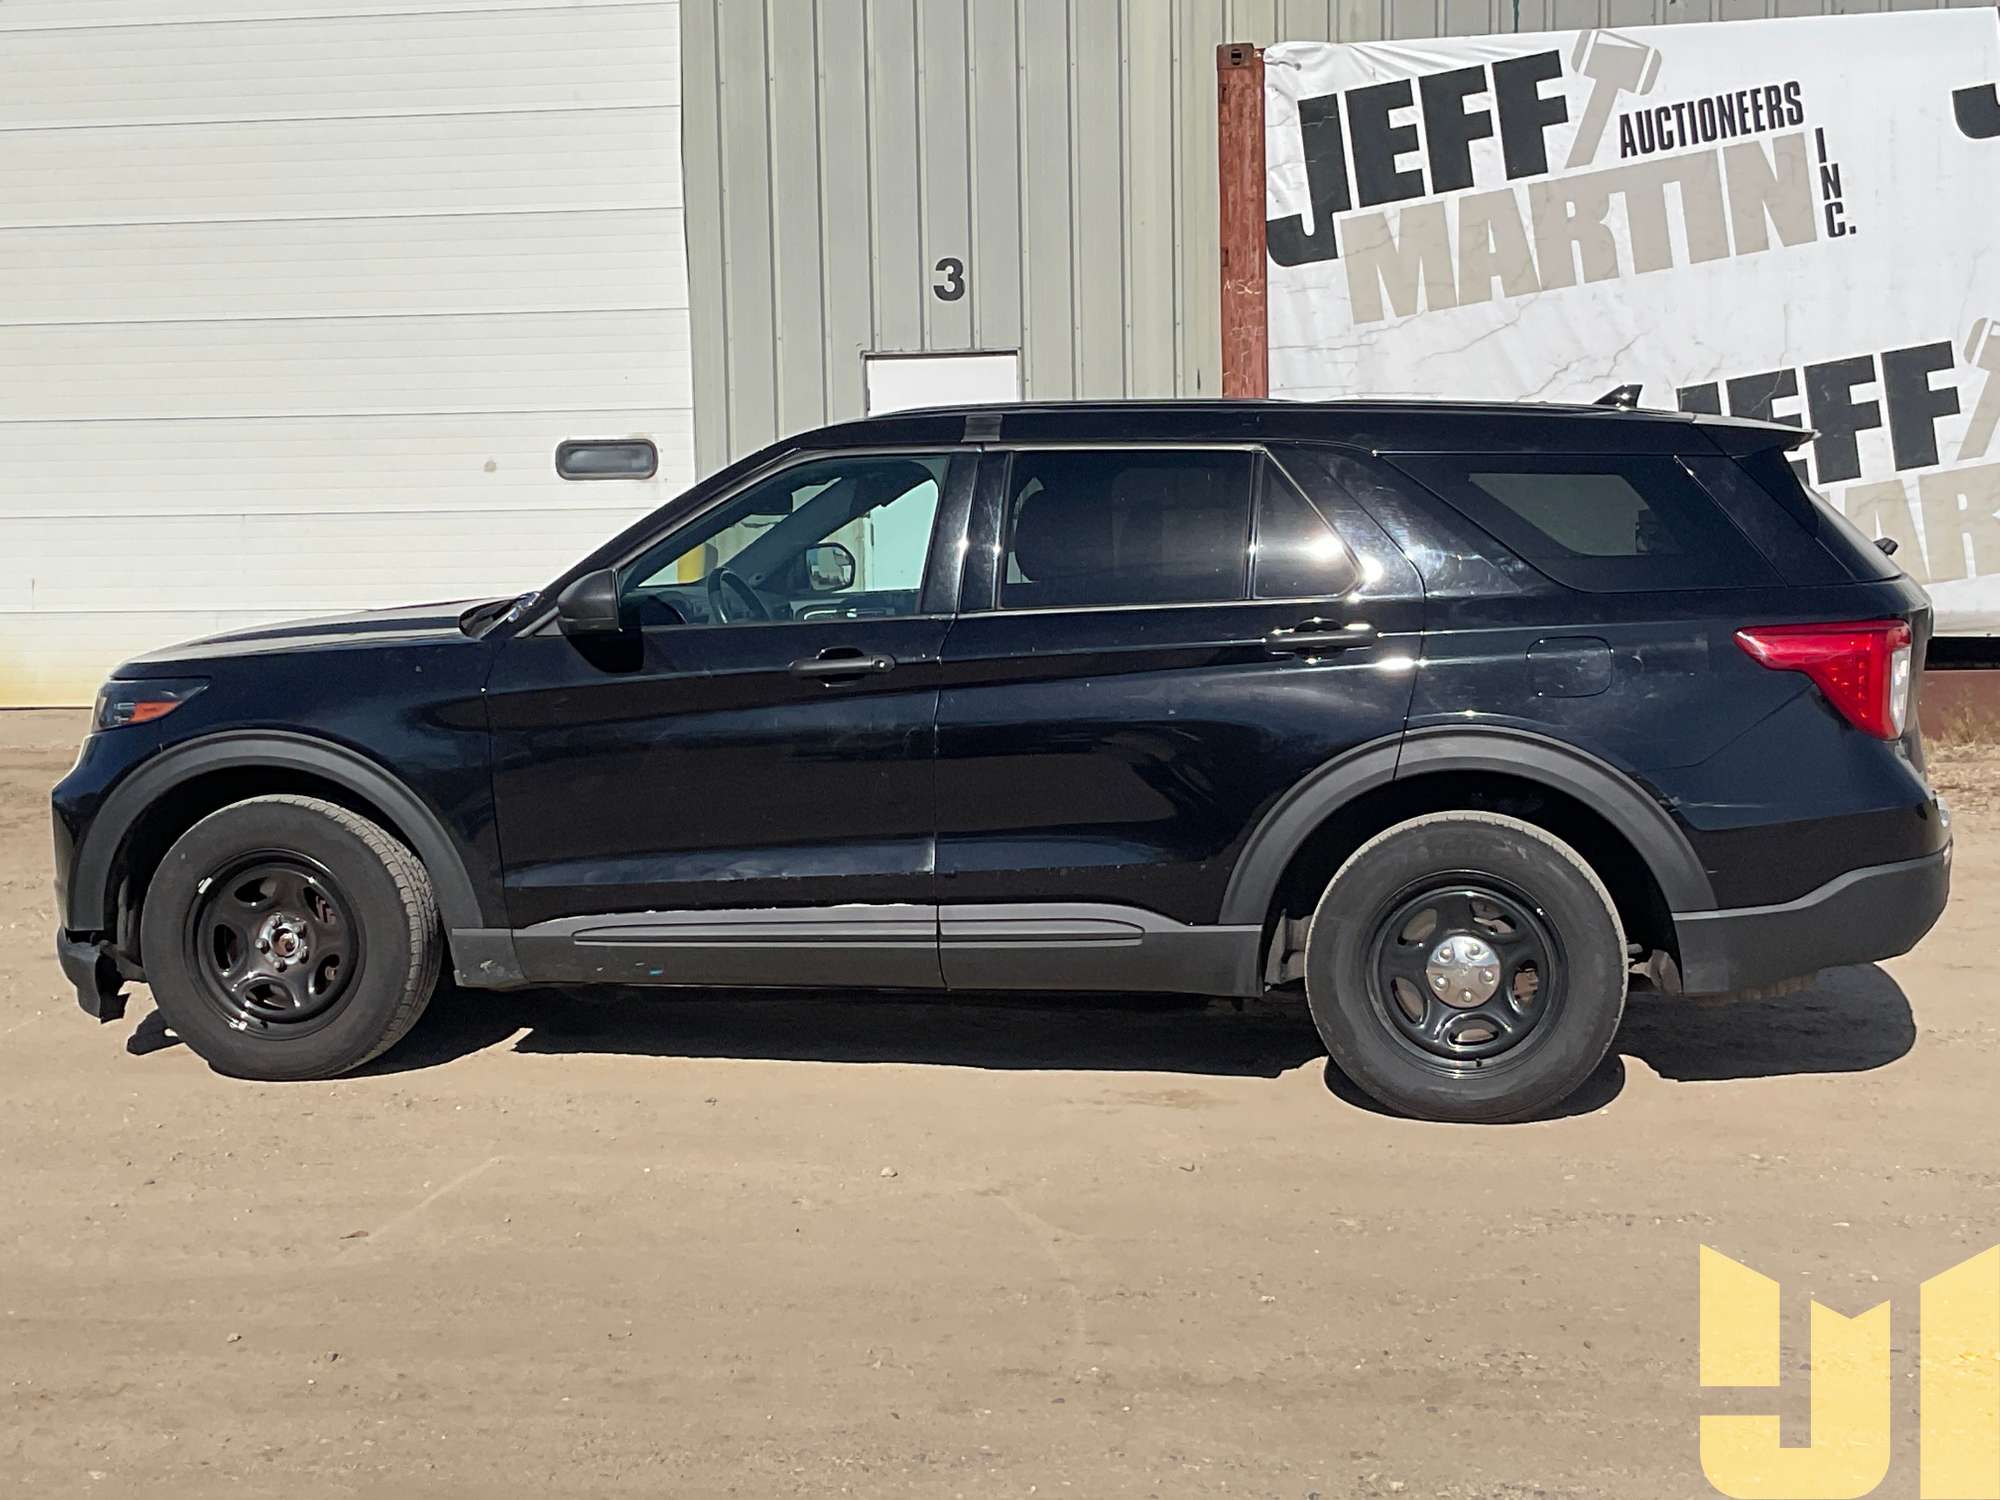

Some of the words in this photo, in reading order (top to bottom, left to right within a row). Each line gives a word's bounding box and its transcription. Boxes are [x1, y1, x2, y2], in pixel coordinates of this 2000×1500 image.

[1266, 50, 1569, 267] JEFF
[1620, 81, 1804, 158] AUCTIONEERS
[1340, 132, 1818, 324] MARTIN
[1815, 127, 1857, 238] INC.
[933, 257, 966, 301] 3
